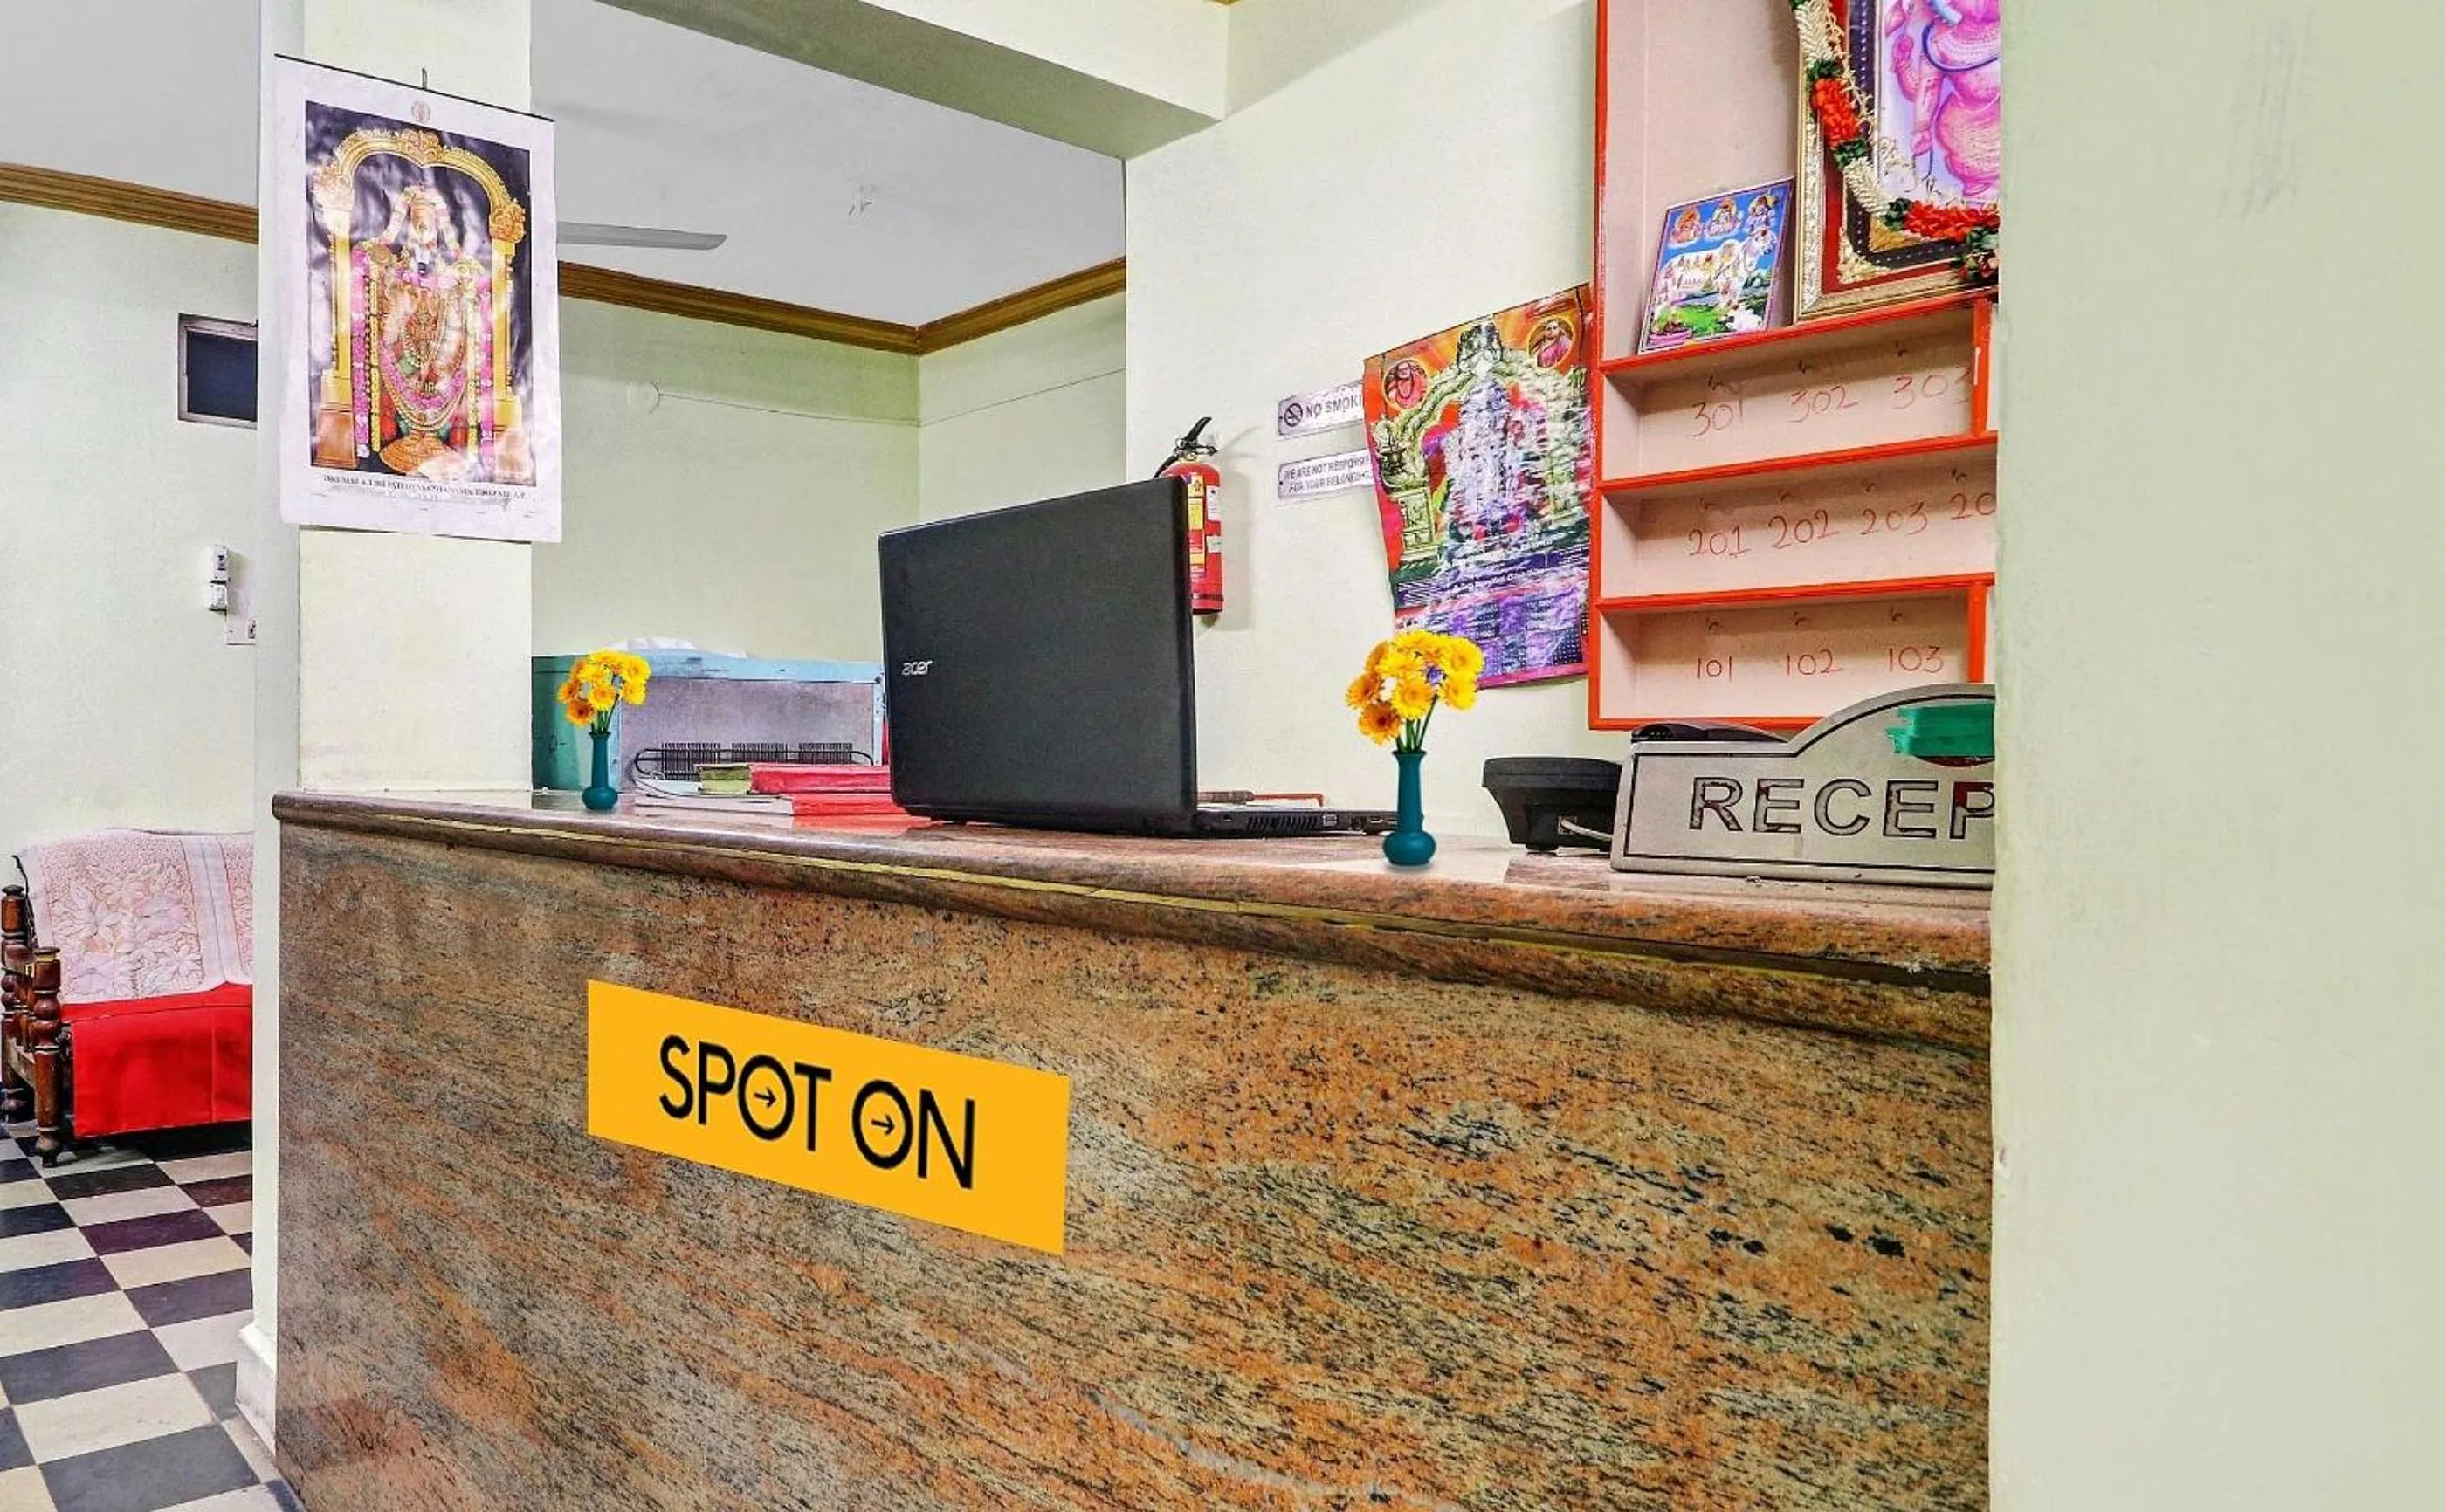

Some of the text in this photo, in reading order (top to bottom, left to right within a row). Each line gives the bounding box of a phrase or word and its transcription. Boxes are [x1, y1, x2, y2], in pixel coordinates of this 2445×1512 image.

[1305, 402, 1323, 418] NO
[1686, 397, 1744, 437] 301
[1787, 385, 1859, 423] 302
[1689, 526, 1752, 556] 201
[1768, 509, 1839, 549] 202
[1860, 500, 1929, 535] 203
[901, 659, 933, 676] acer
[1695, 645, 1945, 681] 101 102 103
[1688, 776, 1995, 840] RECEP
[659, 1034, 976, 1189] SPOT ON
